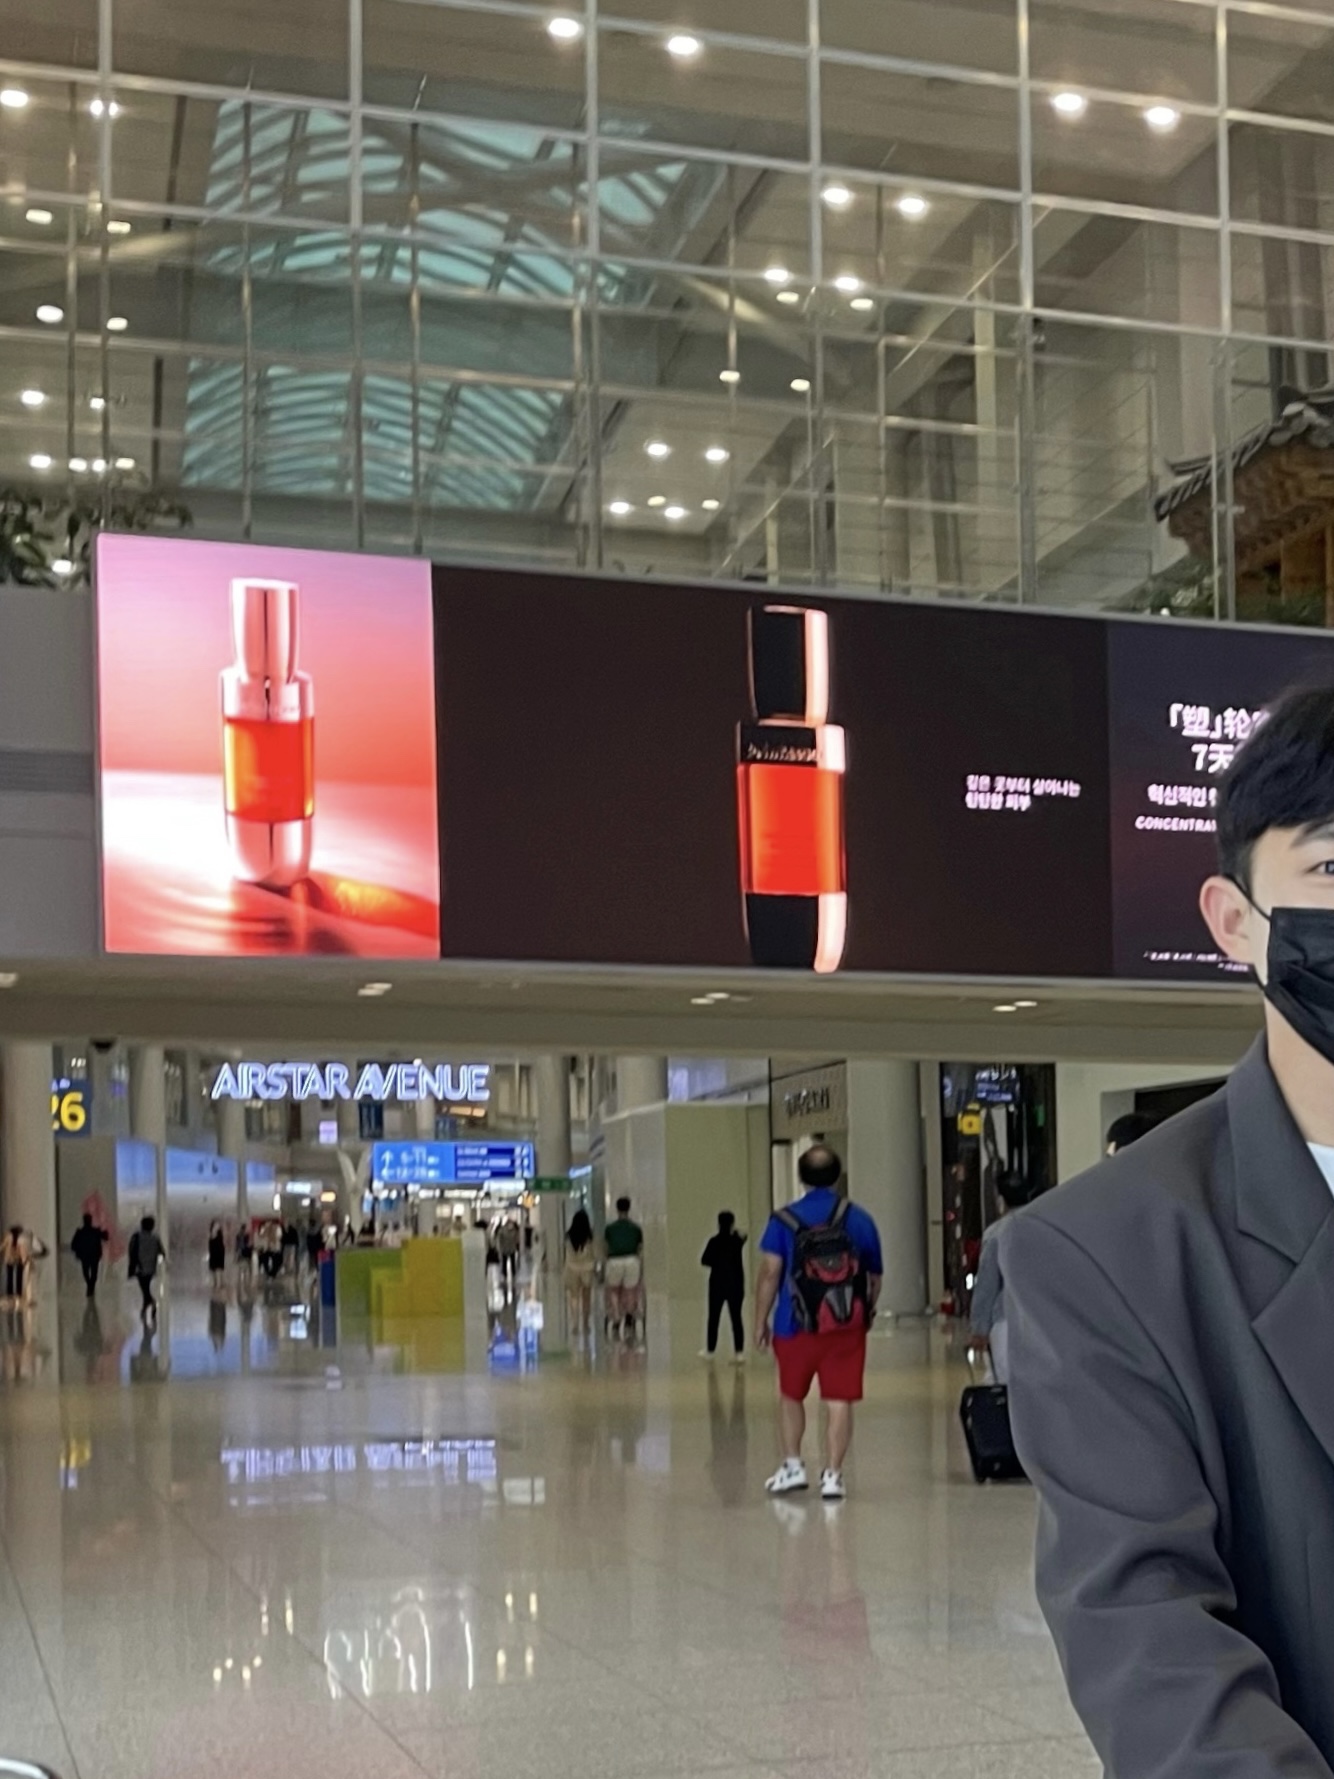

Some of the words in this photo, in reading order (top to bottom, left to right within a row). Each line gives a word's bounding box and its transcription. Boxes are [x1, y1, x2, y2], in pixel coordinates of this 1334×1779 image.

[1147, 783, 1207, 808] 혁신적인
[211, 1062, 350, 1100] AIRSTAR
[353, 1062, 490, 1101] AVENUE
